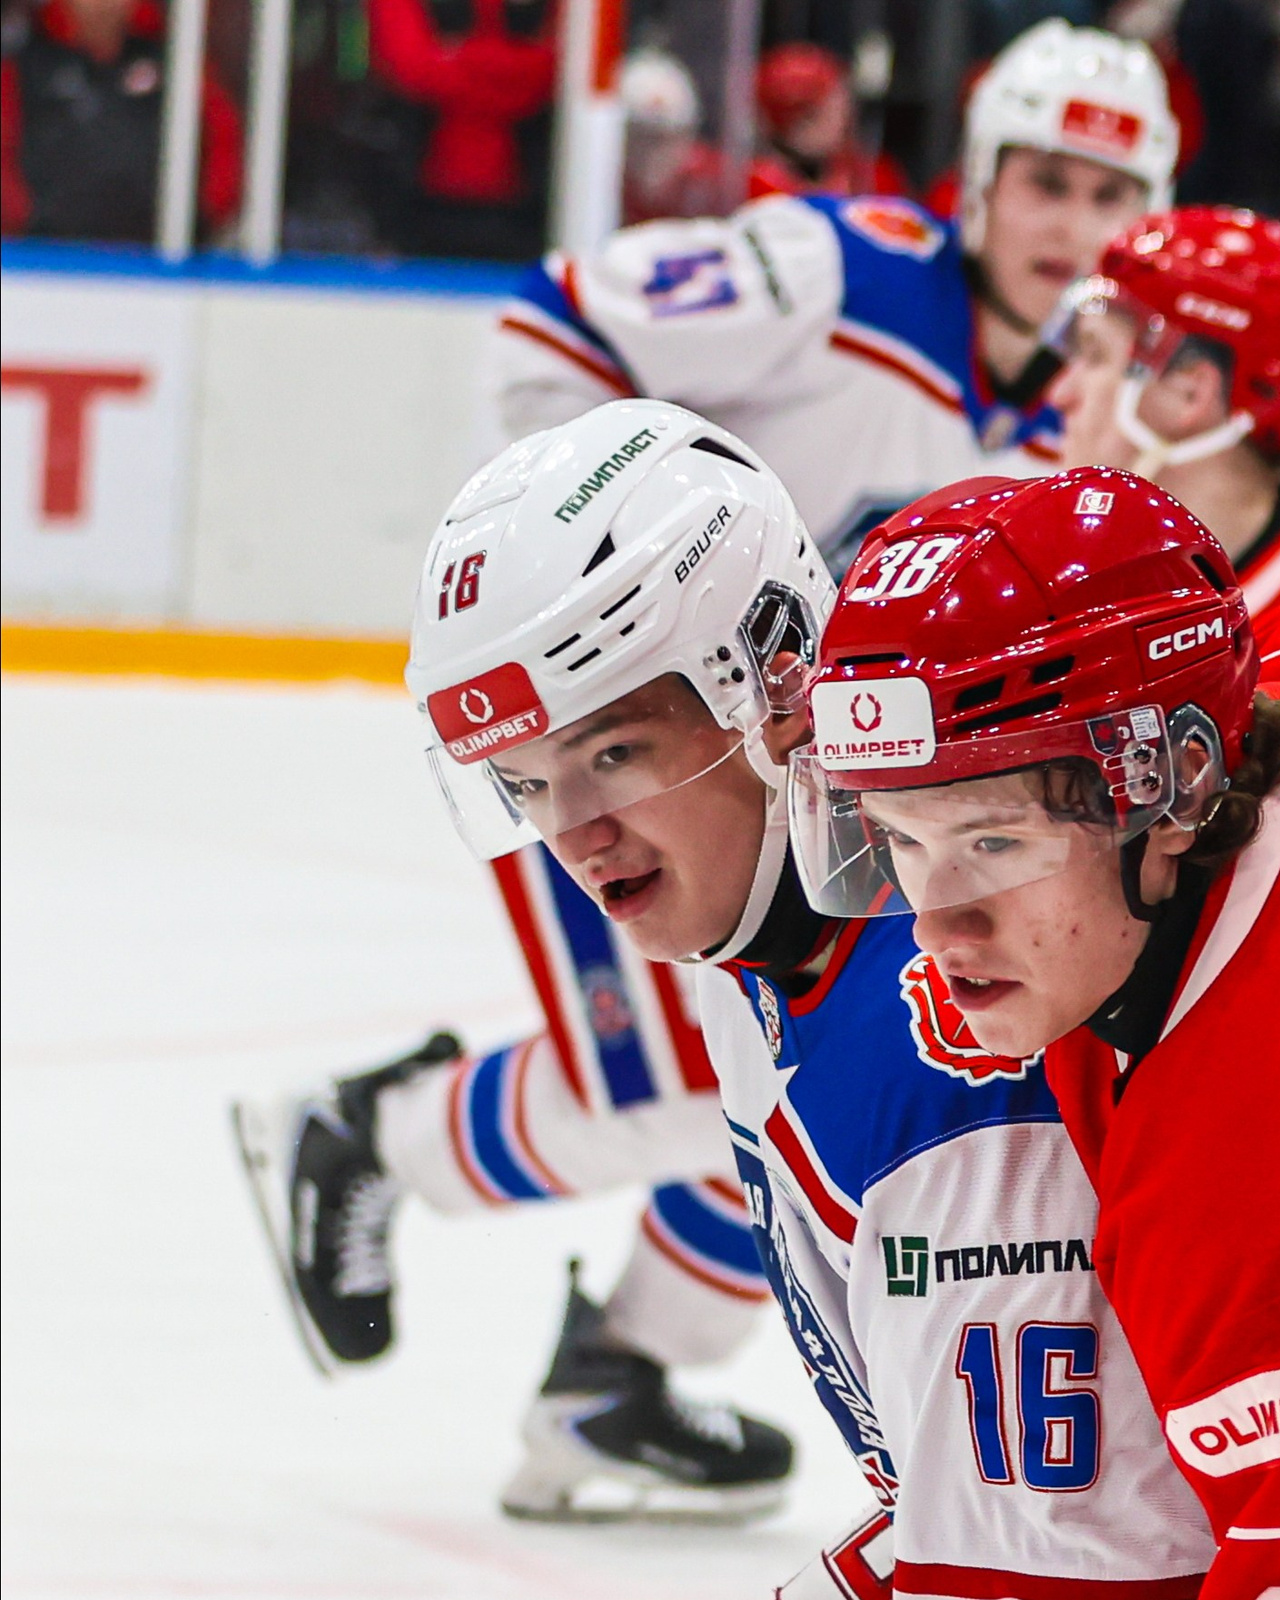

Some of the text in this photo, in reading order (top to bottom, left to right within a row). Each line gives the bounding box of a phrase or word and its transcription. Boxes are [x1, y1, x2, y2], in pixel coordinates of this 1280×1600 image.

[554, 428, 659, 524] ПОЛИПЛАСТ
[674, 505, 732, 584] BAUER
[847, 537, 961, 602] 38
[438, 550, 487, 621] 16
[1148, 617, 1225, 661] CCM
[450, 710, 539, 758] OLIMPBET
[935, 1239, 1095, 1282] ПОЛИПЛ
[956, 1321, 1101, 1492] 16
